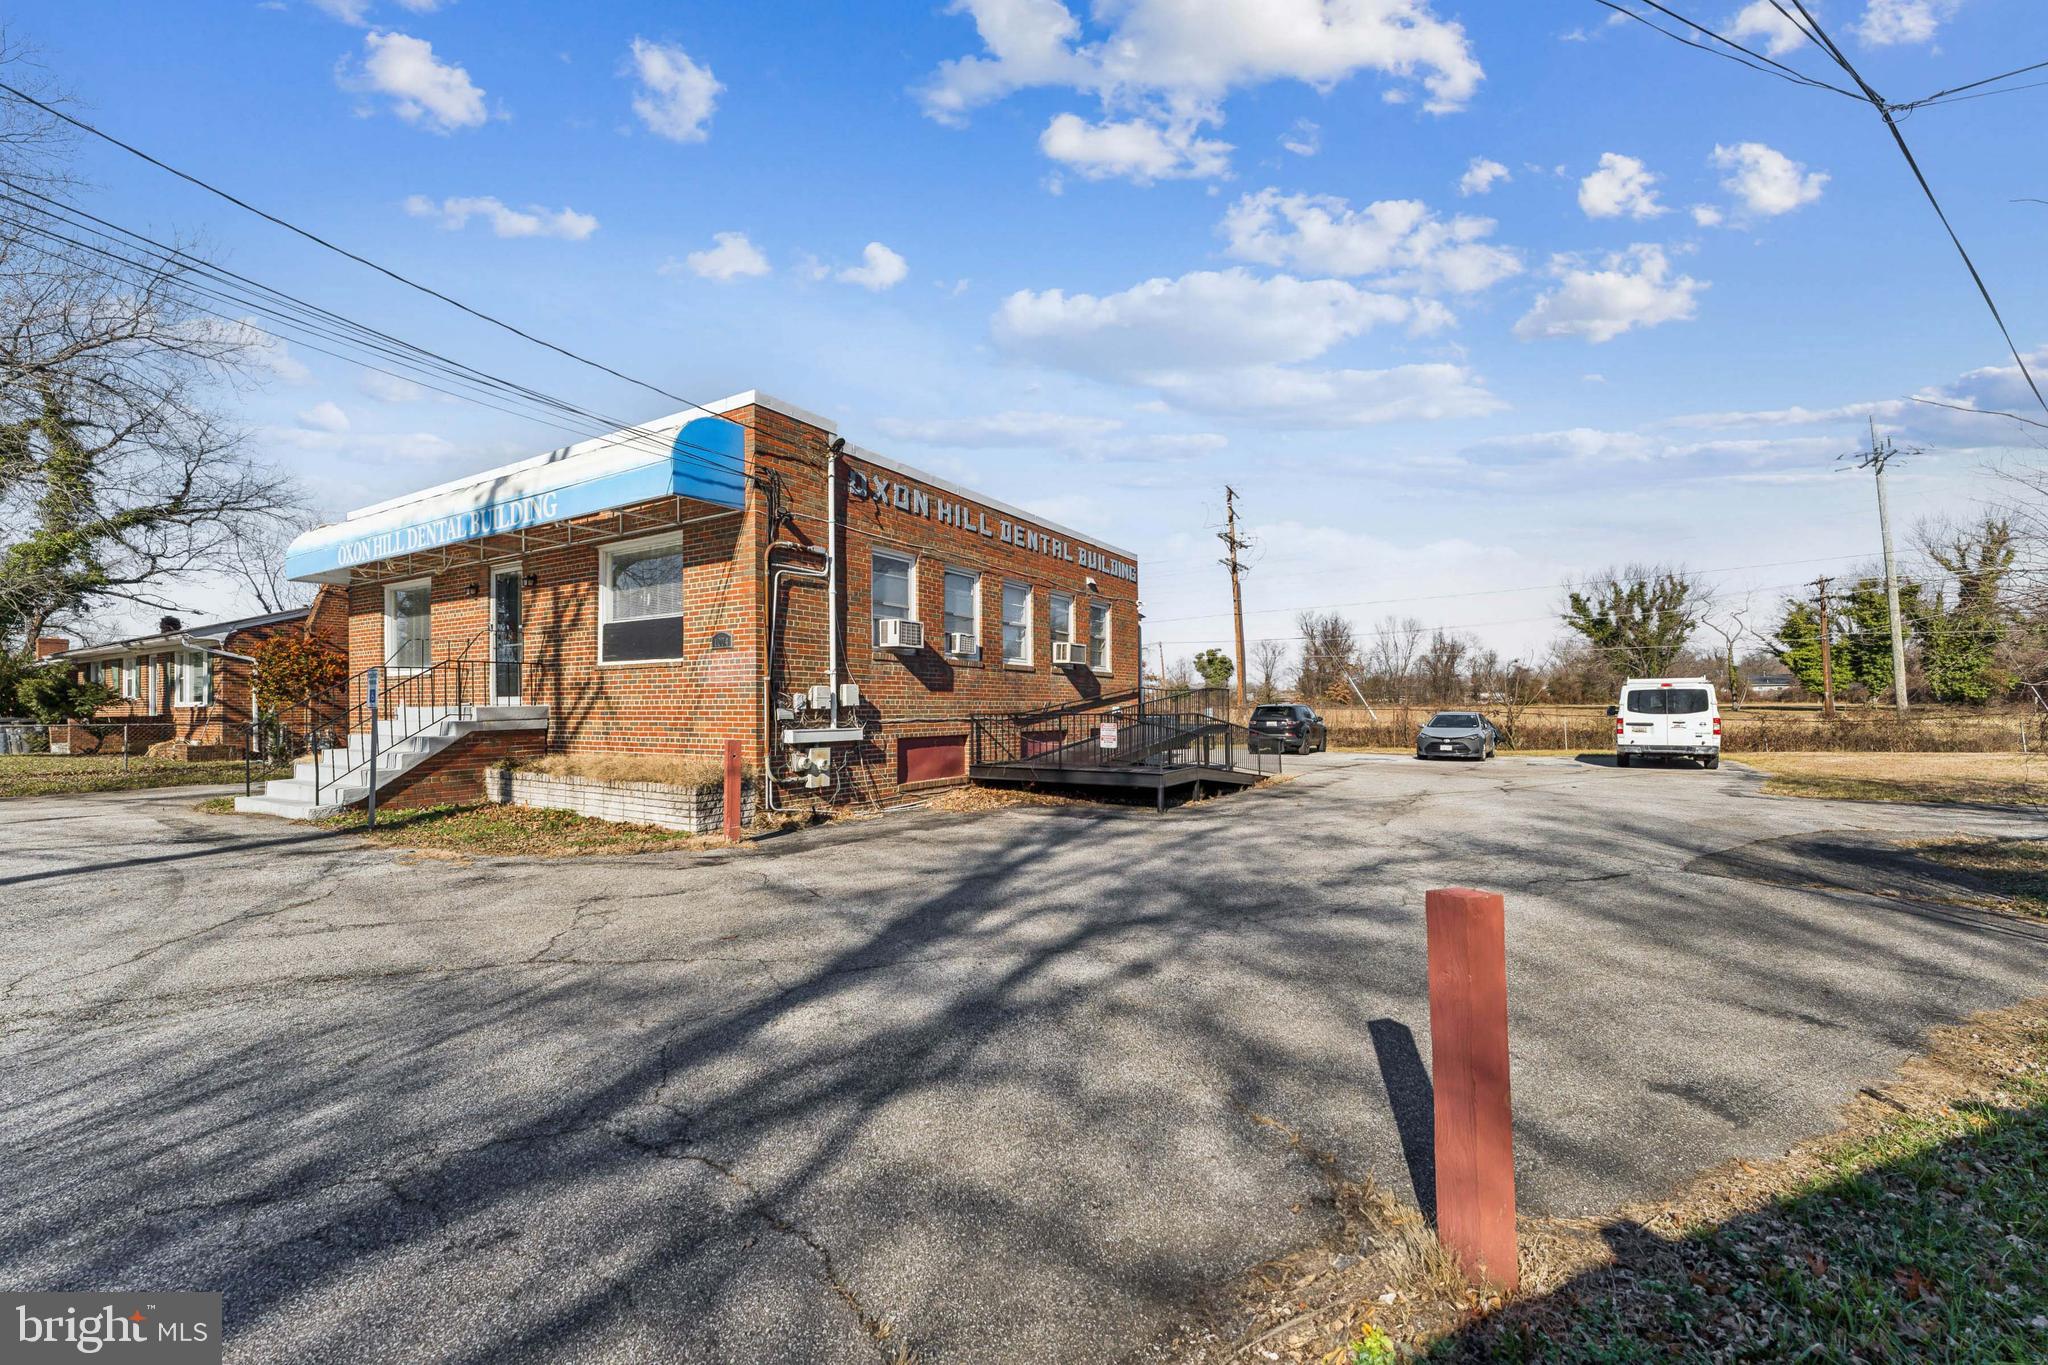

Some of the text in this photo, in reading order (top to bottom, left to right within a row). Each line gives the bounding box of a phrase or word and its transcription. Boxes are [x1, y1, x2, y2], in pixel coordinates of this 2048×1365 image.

[337, 491, 558, 565] OXON HILL DENTAL BUILDING
[848, 468, 1138, 582] OXON HILL DENTAL BUILDING
